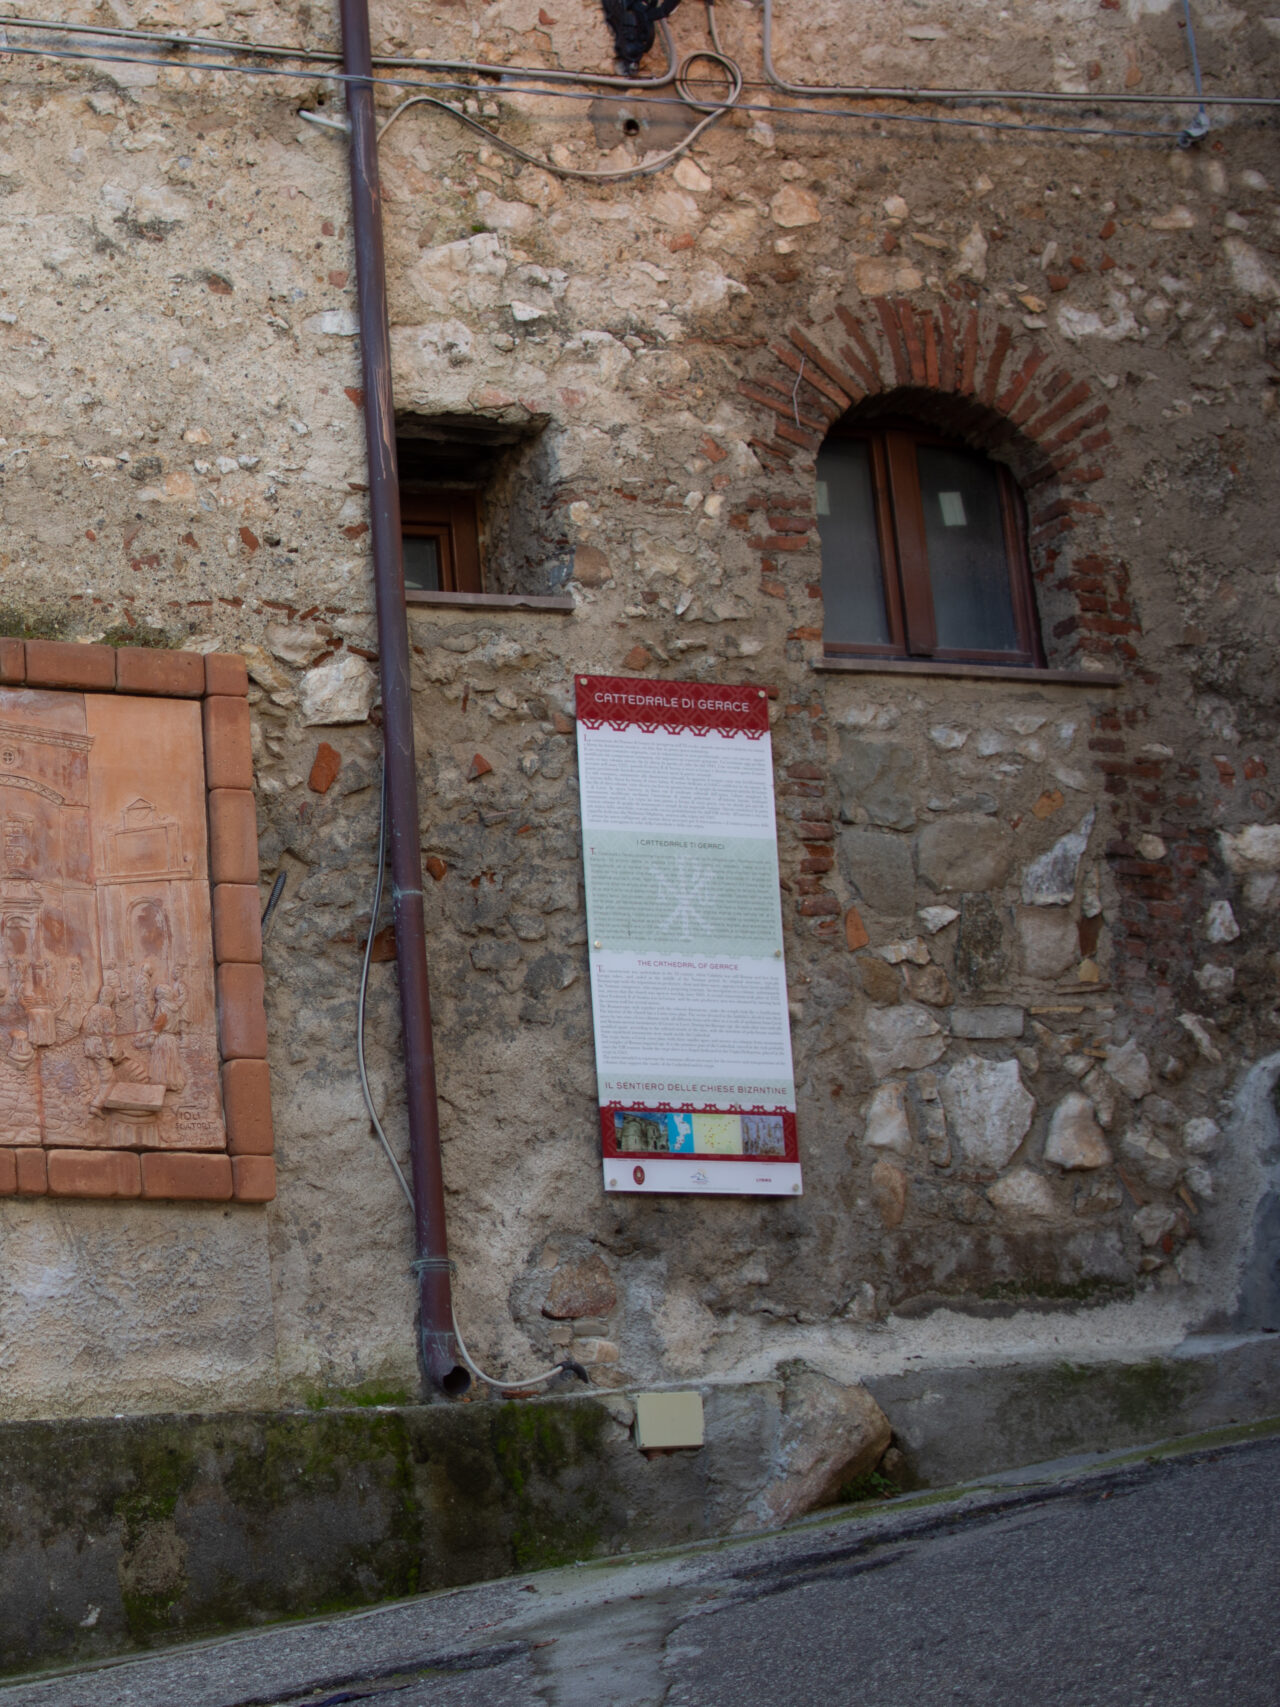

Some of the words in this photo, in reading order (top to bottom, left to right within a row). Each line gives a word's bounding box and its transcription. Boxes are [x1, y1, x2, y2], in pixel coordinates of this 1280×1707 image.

[594, 692, 679, 708] CATTEDRALE
[682, 698, 695, 709] DI
[697, 699, 750, 713] GERACE
[637, 959, 652, 967] THE
[653, 960, 697, 969] CATHEDRAL
[709, 962, 739, 971] GERACE
[604, 1081, 613, 1089] IL
[616, 1082, 665, 1091] SENTIERO
[667, 1083, 698, 1092] DELLE
[700, 1084, 735, 1093] CHIESE
[737, 1085, 788, 1095] BIZANTINE
